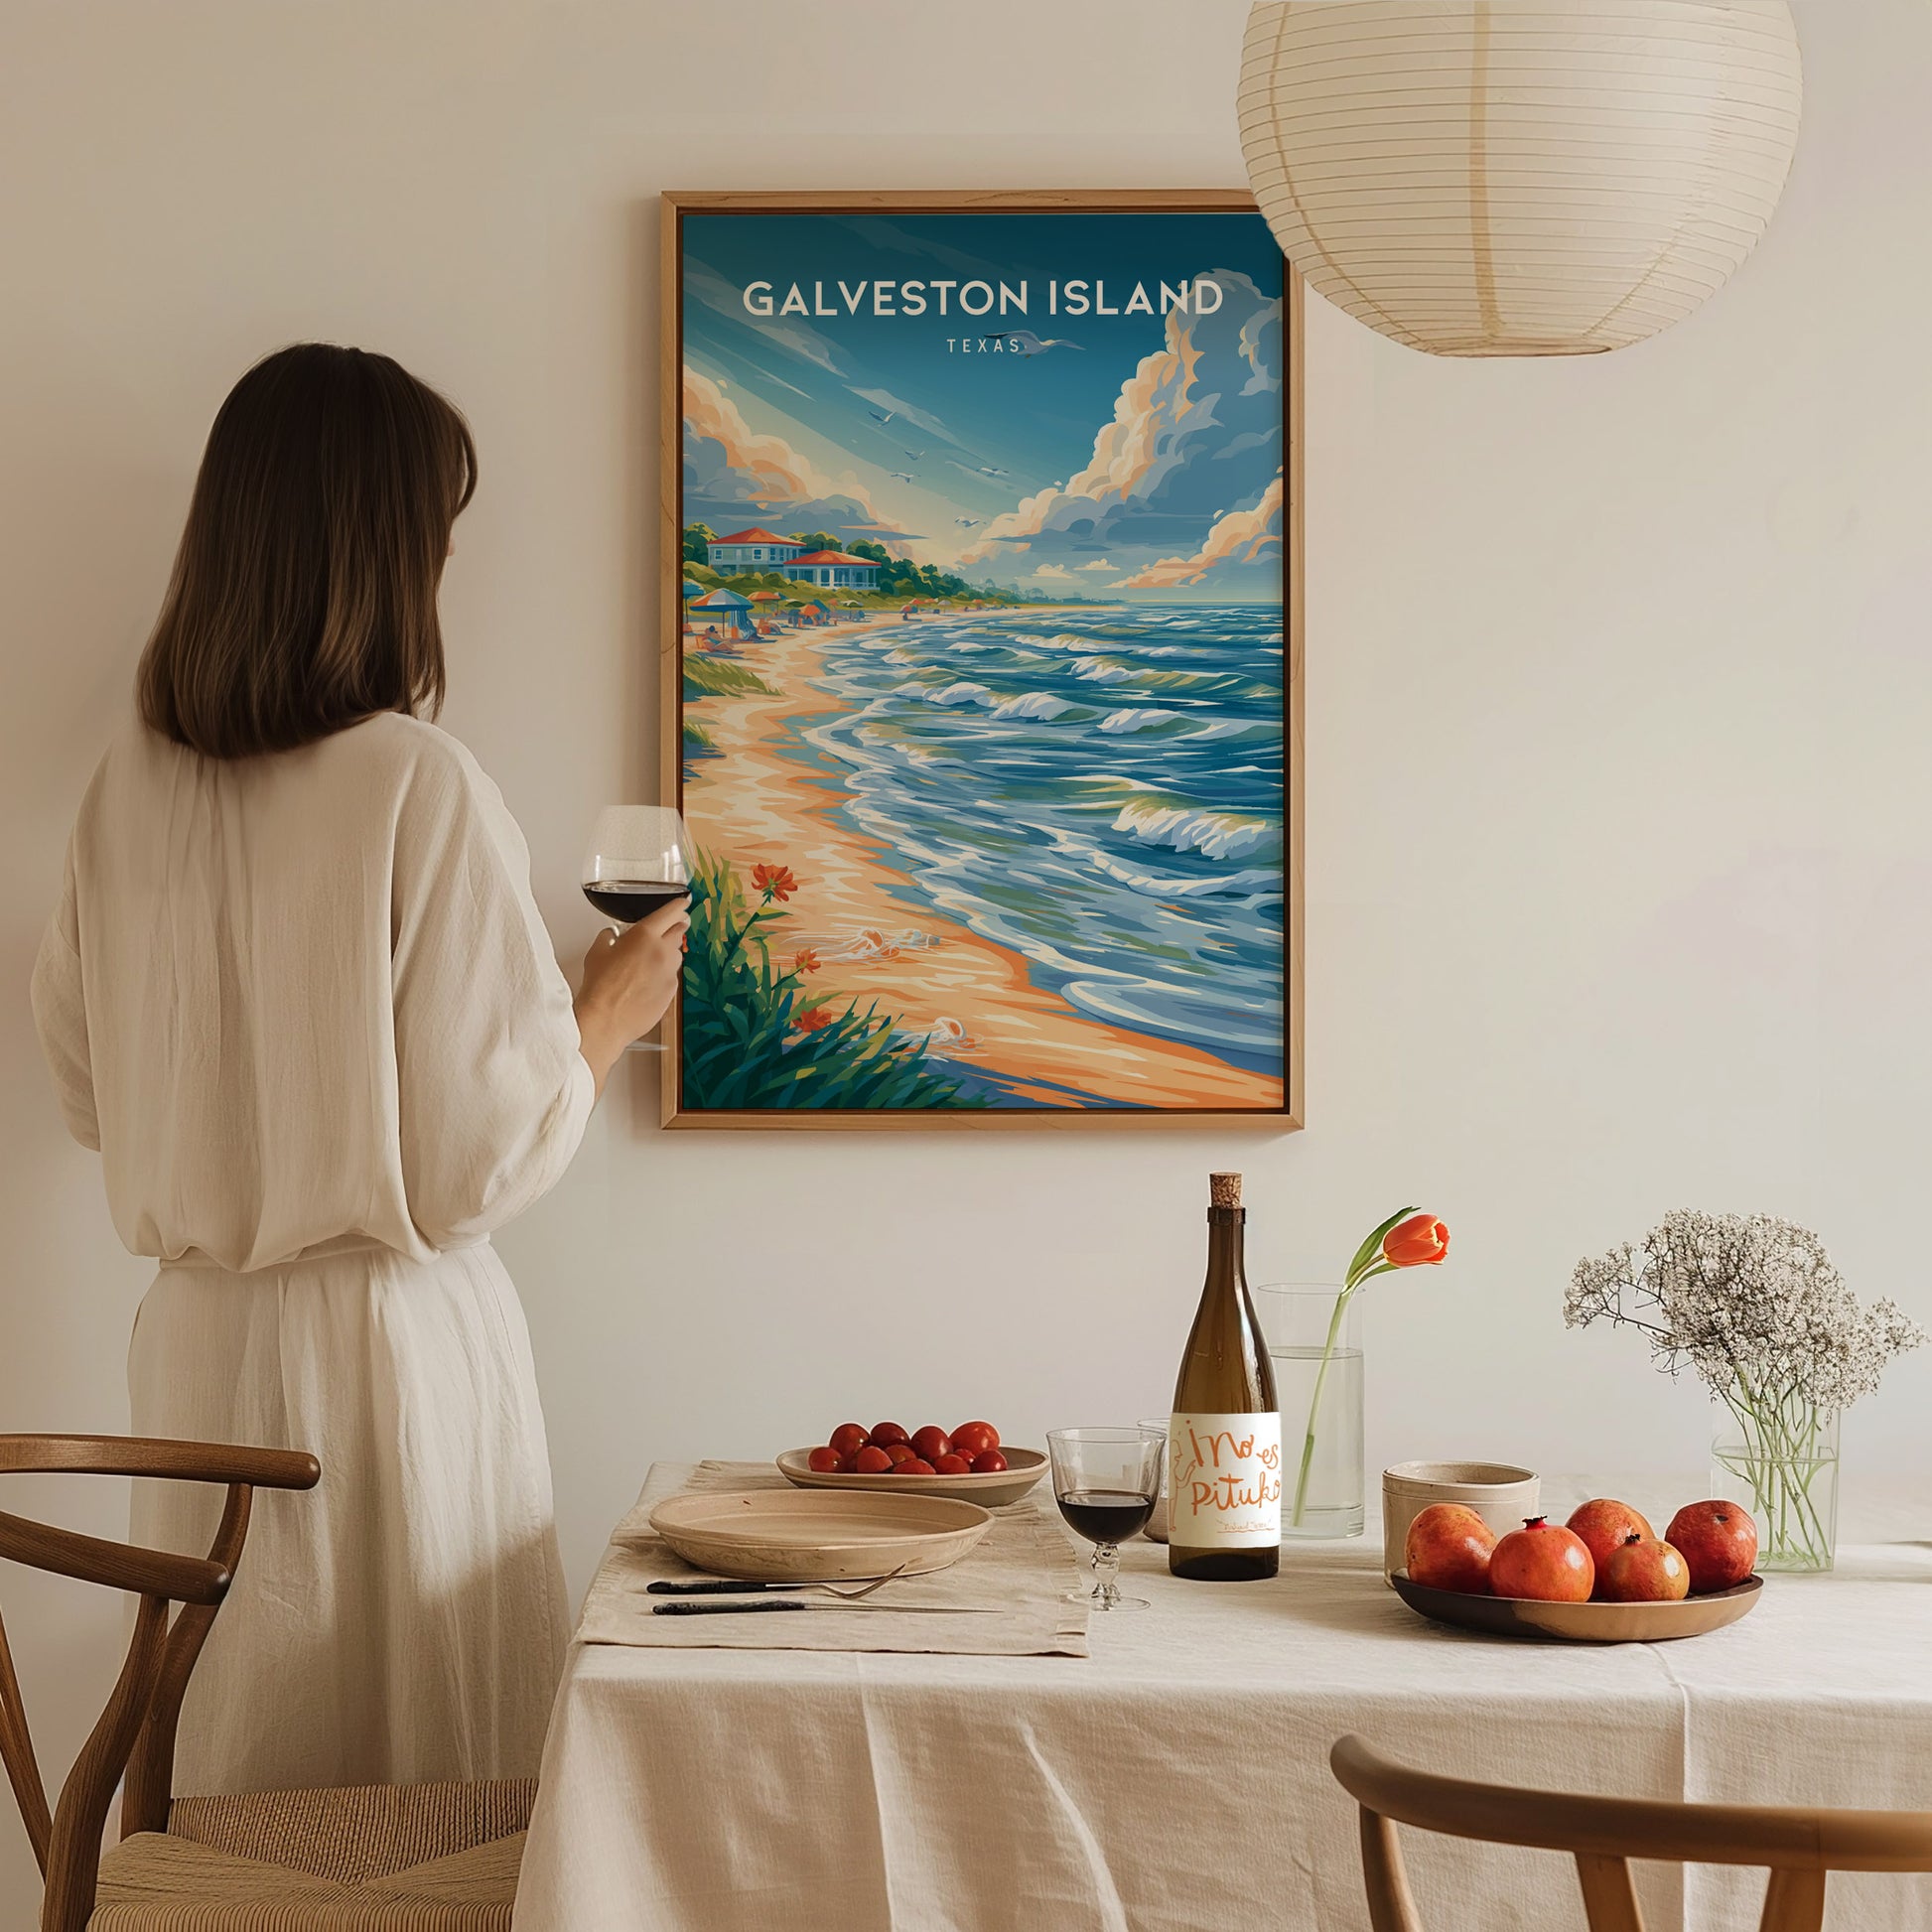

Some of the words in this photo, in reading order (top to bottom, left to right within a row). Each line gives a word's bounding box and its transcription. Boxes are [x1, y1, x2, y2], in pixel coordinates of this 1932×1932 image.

[743, 280, 1029, 316] GALVESTON
[1049, 280, 1224, 316] ISLAND
[946, 339, 1020, 353] TEXAS
